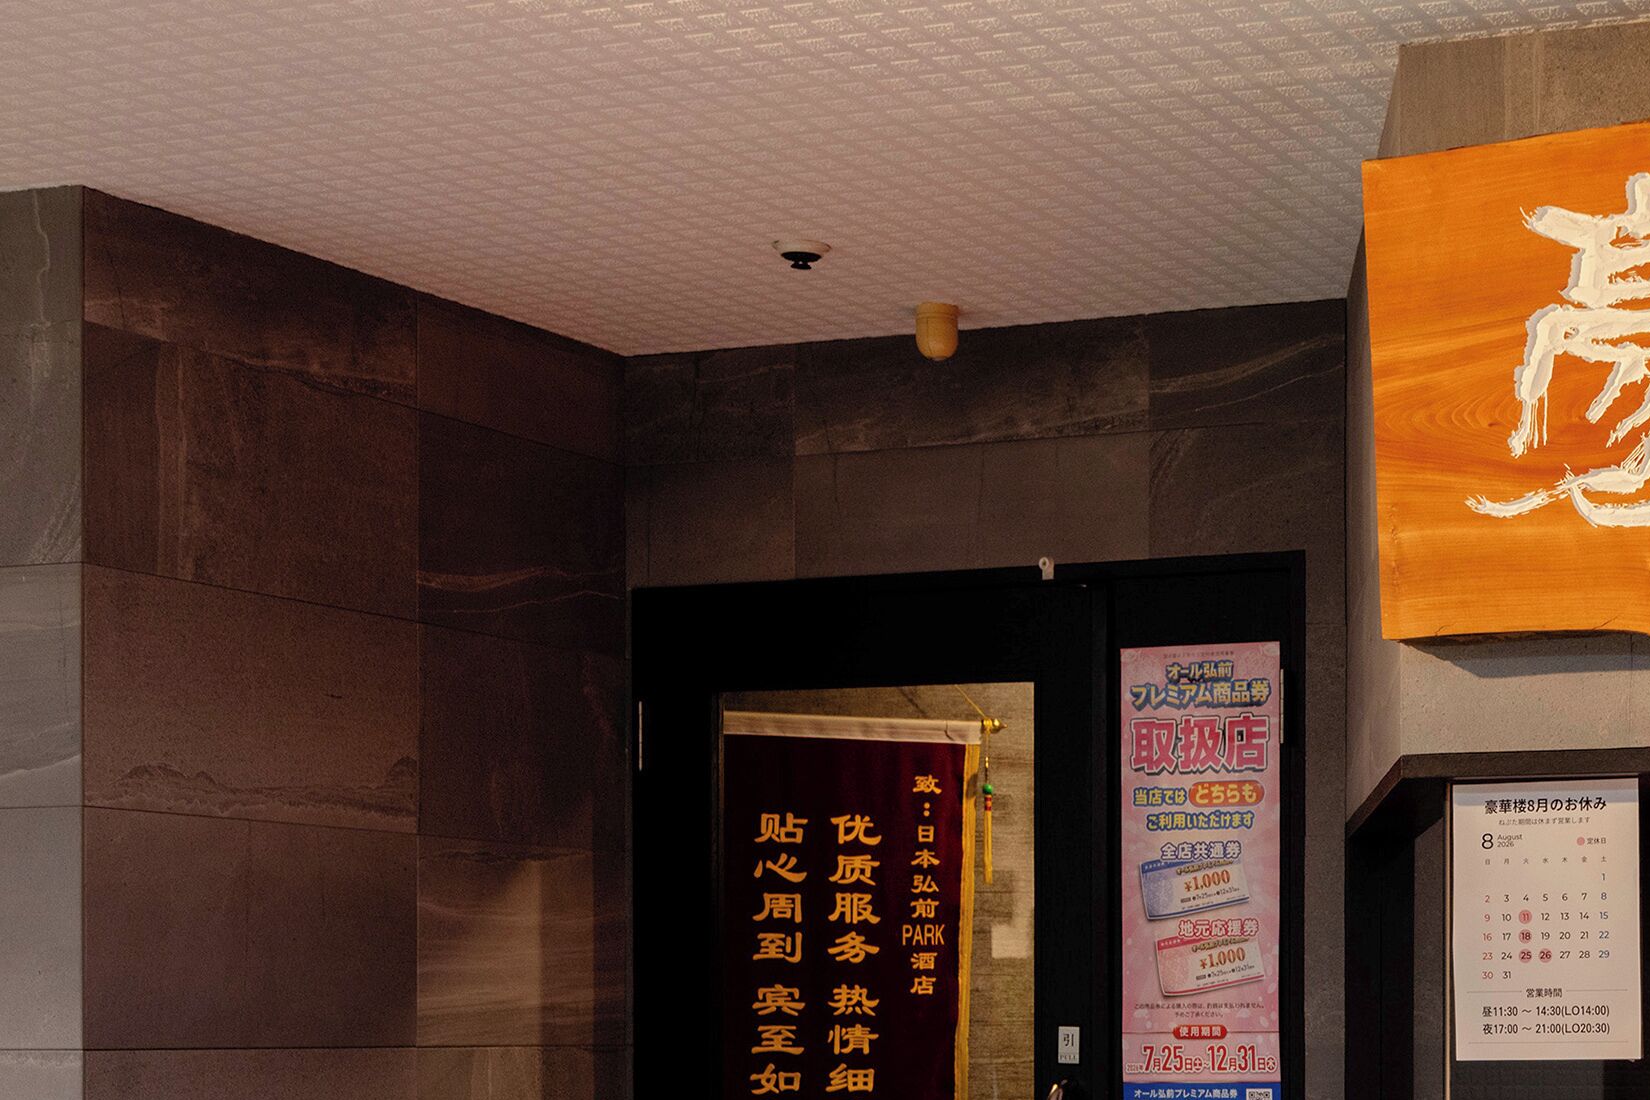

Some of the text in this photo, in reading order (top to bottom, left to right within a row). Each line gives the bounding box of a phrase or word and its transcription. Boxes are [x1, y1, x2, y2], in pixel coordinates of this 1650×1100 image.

[1167, 661, 1234, 680] オール弘前
[1131, 679, 1271, 708] プレミアム商品券
[1131, 714, 1269, 774] 取扱店
[1484, 796, 1607, 814] 豪華楼8月のお休み
[1147, 811, 1255, 831] ご利用いただけます
[1482, 833, 1493, 849] 8
[1497, 833, 1523, 842] August
[1587, 837, 1606, 845] 定休日
[1161, 842, 1241, 861] 全店共通券
[752, 812, 808, 964] 贴心周到
[1184, 870, 1231, 893] ¥1,000
[827, 813, 882, 964] 优质服务
[1485, 895, 1490, 903] 2
[1504, 894, 1509, 902] 3
[1562, 893, 1568, 901] 6
[1582, 893, 1587, 901] 7
[1601, 892, 1607, 900] 8
[1485, 914, 1490, 922] 9
[1502, 913, 1511, 921] 10
[1523, 913, 1529, 921] 11
[1541, 913, 1550, 921] 12
[1561, 912, 1569, 920] 13
[1579, 912, 1589, 920] 14
[1178, 919, 1259, 938] 地元応援券
[1483, 933, 1492, 941] 16
[1502, 933, 1511, 941] 17
[1522, 932, 1530, 940] 18
[1541, 932, 1550, 940] 19
[1580, 931, 1589, 939] 21
[1599, 931, 1609, 939] 22
[1200, 947, 1246, 970] ¥1,000
[1483, 951, 1609, 960] 23 24 25 26 27 28 29
[1482, 971, 1511, 979] 30 31
[1526, 988, 1562, 997] 営業時間
[1483, 1006, 1518, 1017] 昼11:30
[1536, 1005, 1610, 1017] 14:30(LO14:00)
[1179, 1026, 1222, 1037] 使用期間
[1483, 1024, 1518, 1034] 夜17:00
[1536, 1024, 1610, 1034] 21:00(LO20:30)
[1063, 1034, 1074, 1047] 引
[1134, 1089, 1238, 1099] オール弘前プレミアム商品券
